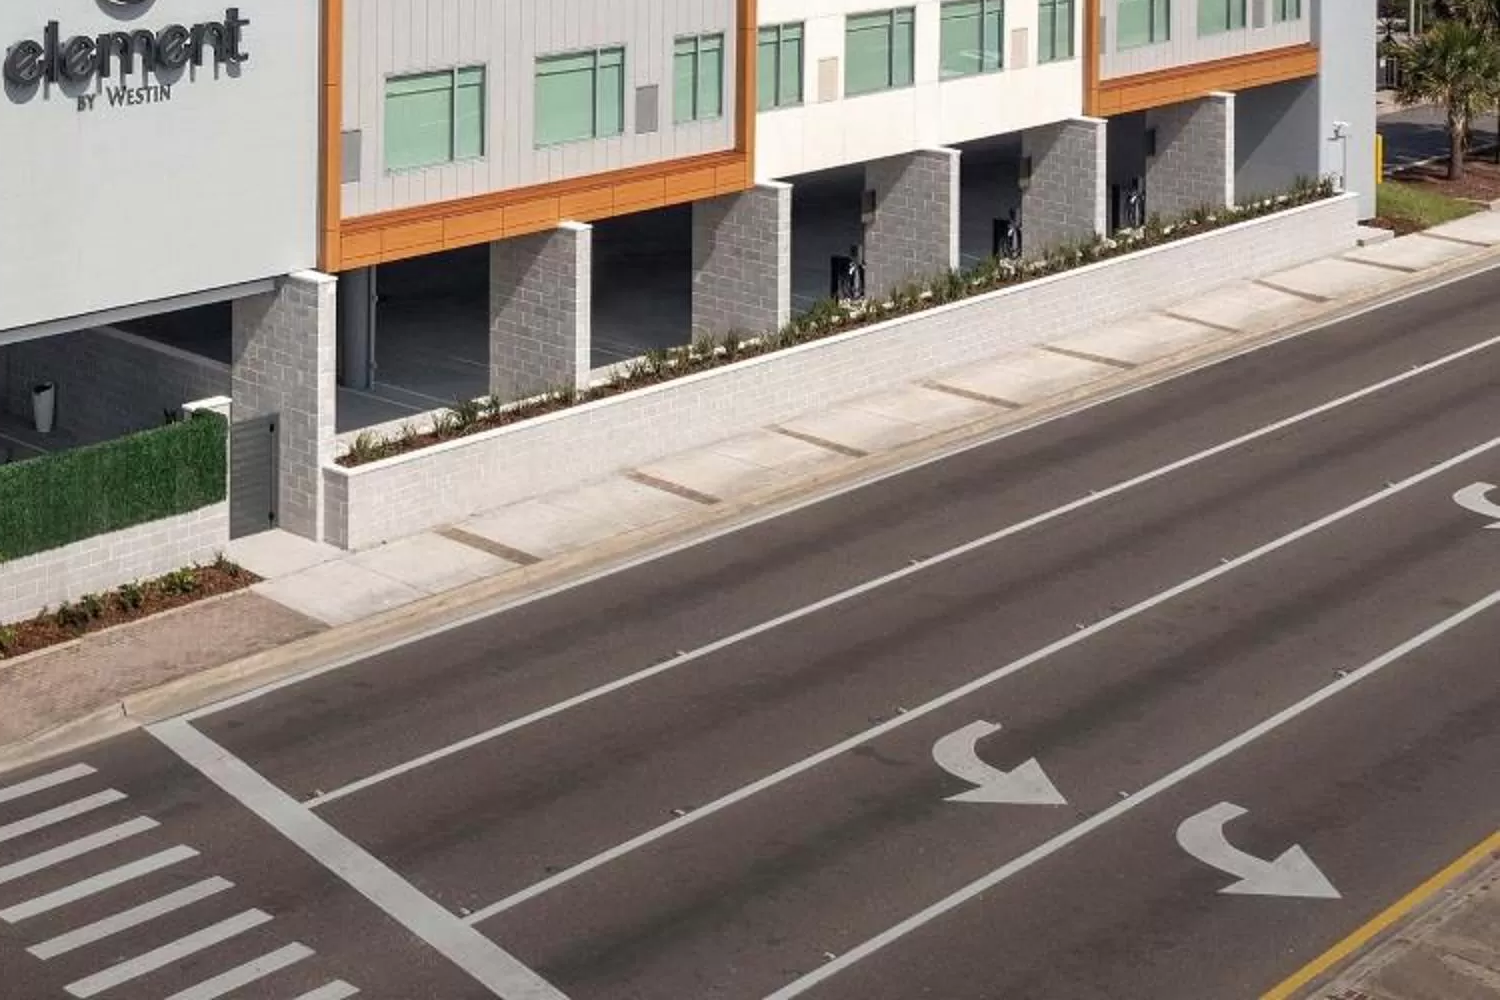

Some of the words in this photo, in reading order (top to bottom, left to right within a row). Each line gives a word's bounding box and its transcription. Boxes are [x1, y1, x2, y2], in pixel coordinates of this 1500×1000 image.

[5, 8, 250, 83] element
[77, 94, 96, 112] BY
[106, 83, 171, 107] WESTIN
